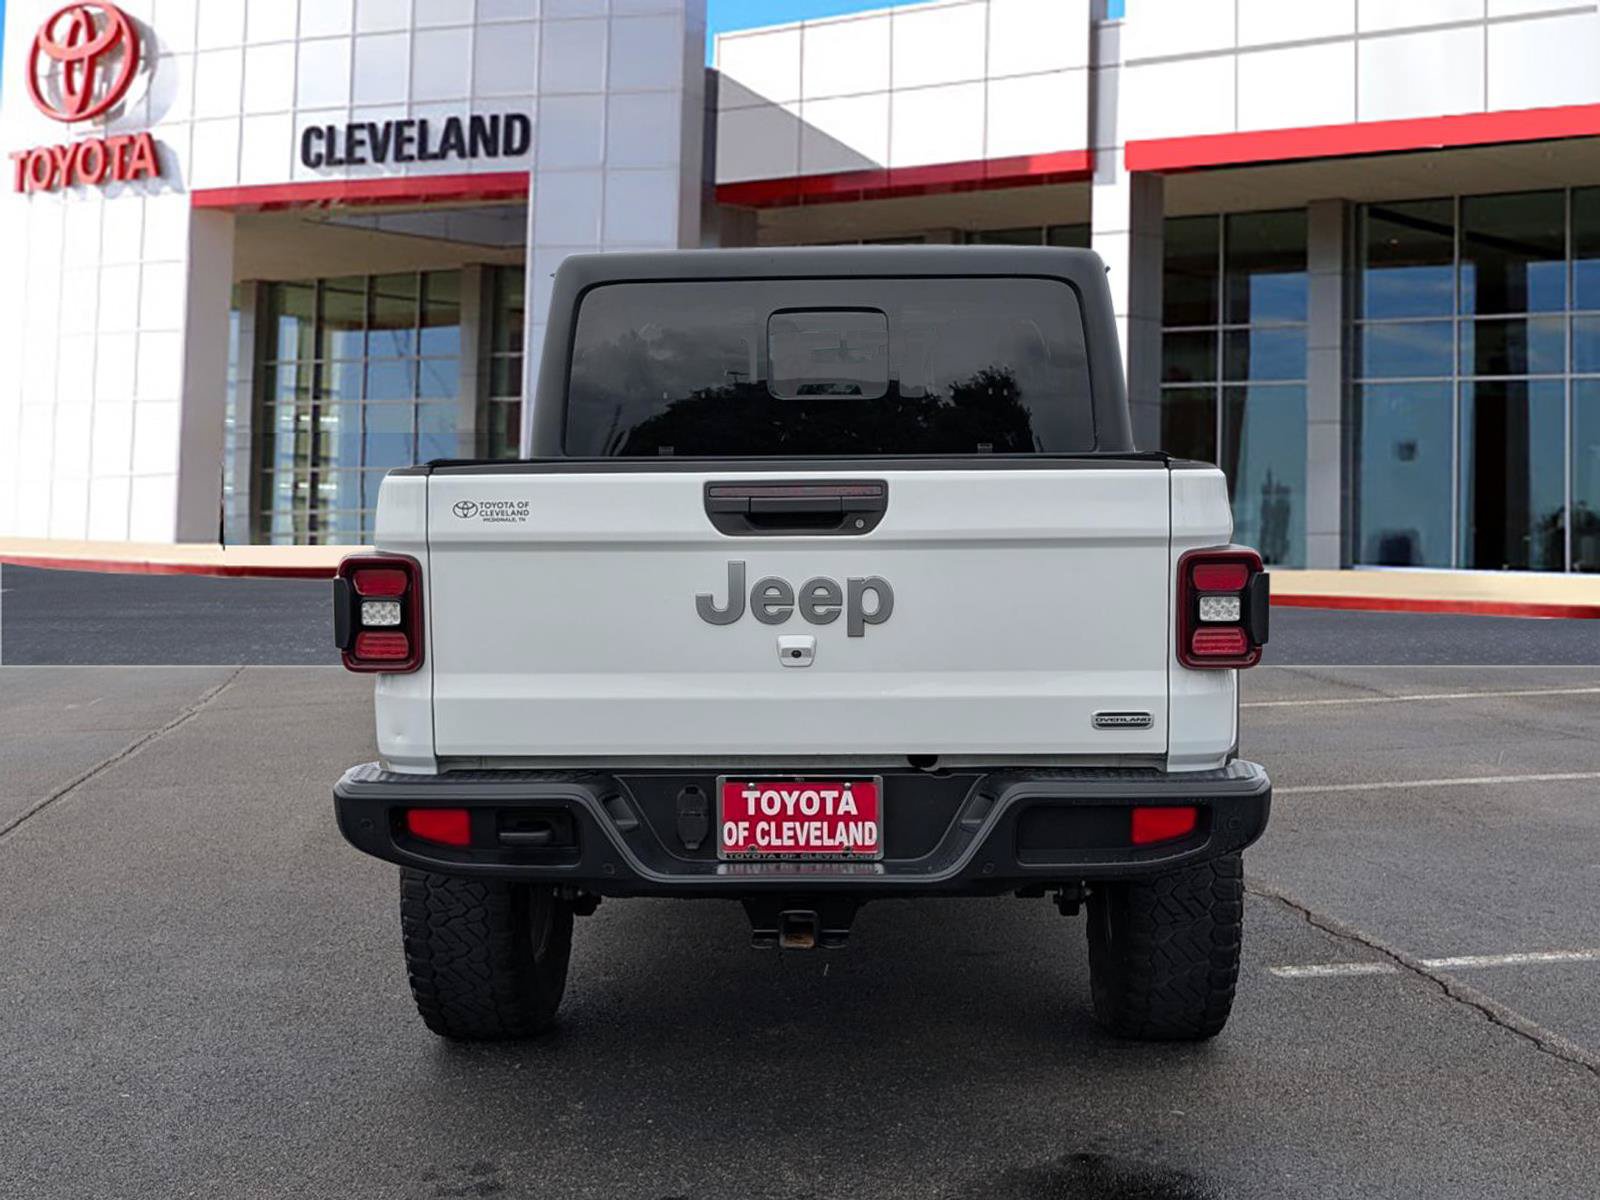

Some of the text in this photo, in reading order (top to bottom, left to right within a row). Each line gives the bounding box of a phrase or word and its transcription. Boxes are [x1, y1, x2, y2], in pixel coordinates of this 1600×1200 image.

[301, 112, 531, 169] CLEVELAND
[9, 131, 161, 193] TOYOTA
[479, 509, 529, 517] CLEVELAND
[480, 501, 529, 509] TOYOTA OF
[695, 560, 895, 638] Jeep
[741, 790, 858, 816] TOYOTA
[723, 821, 878, 847] OF CLEVELAND
